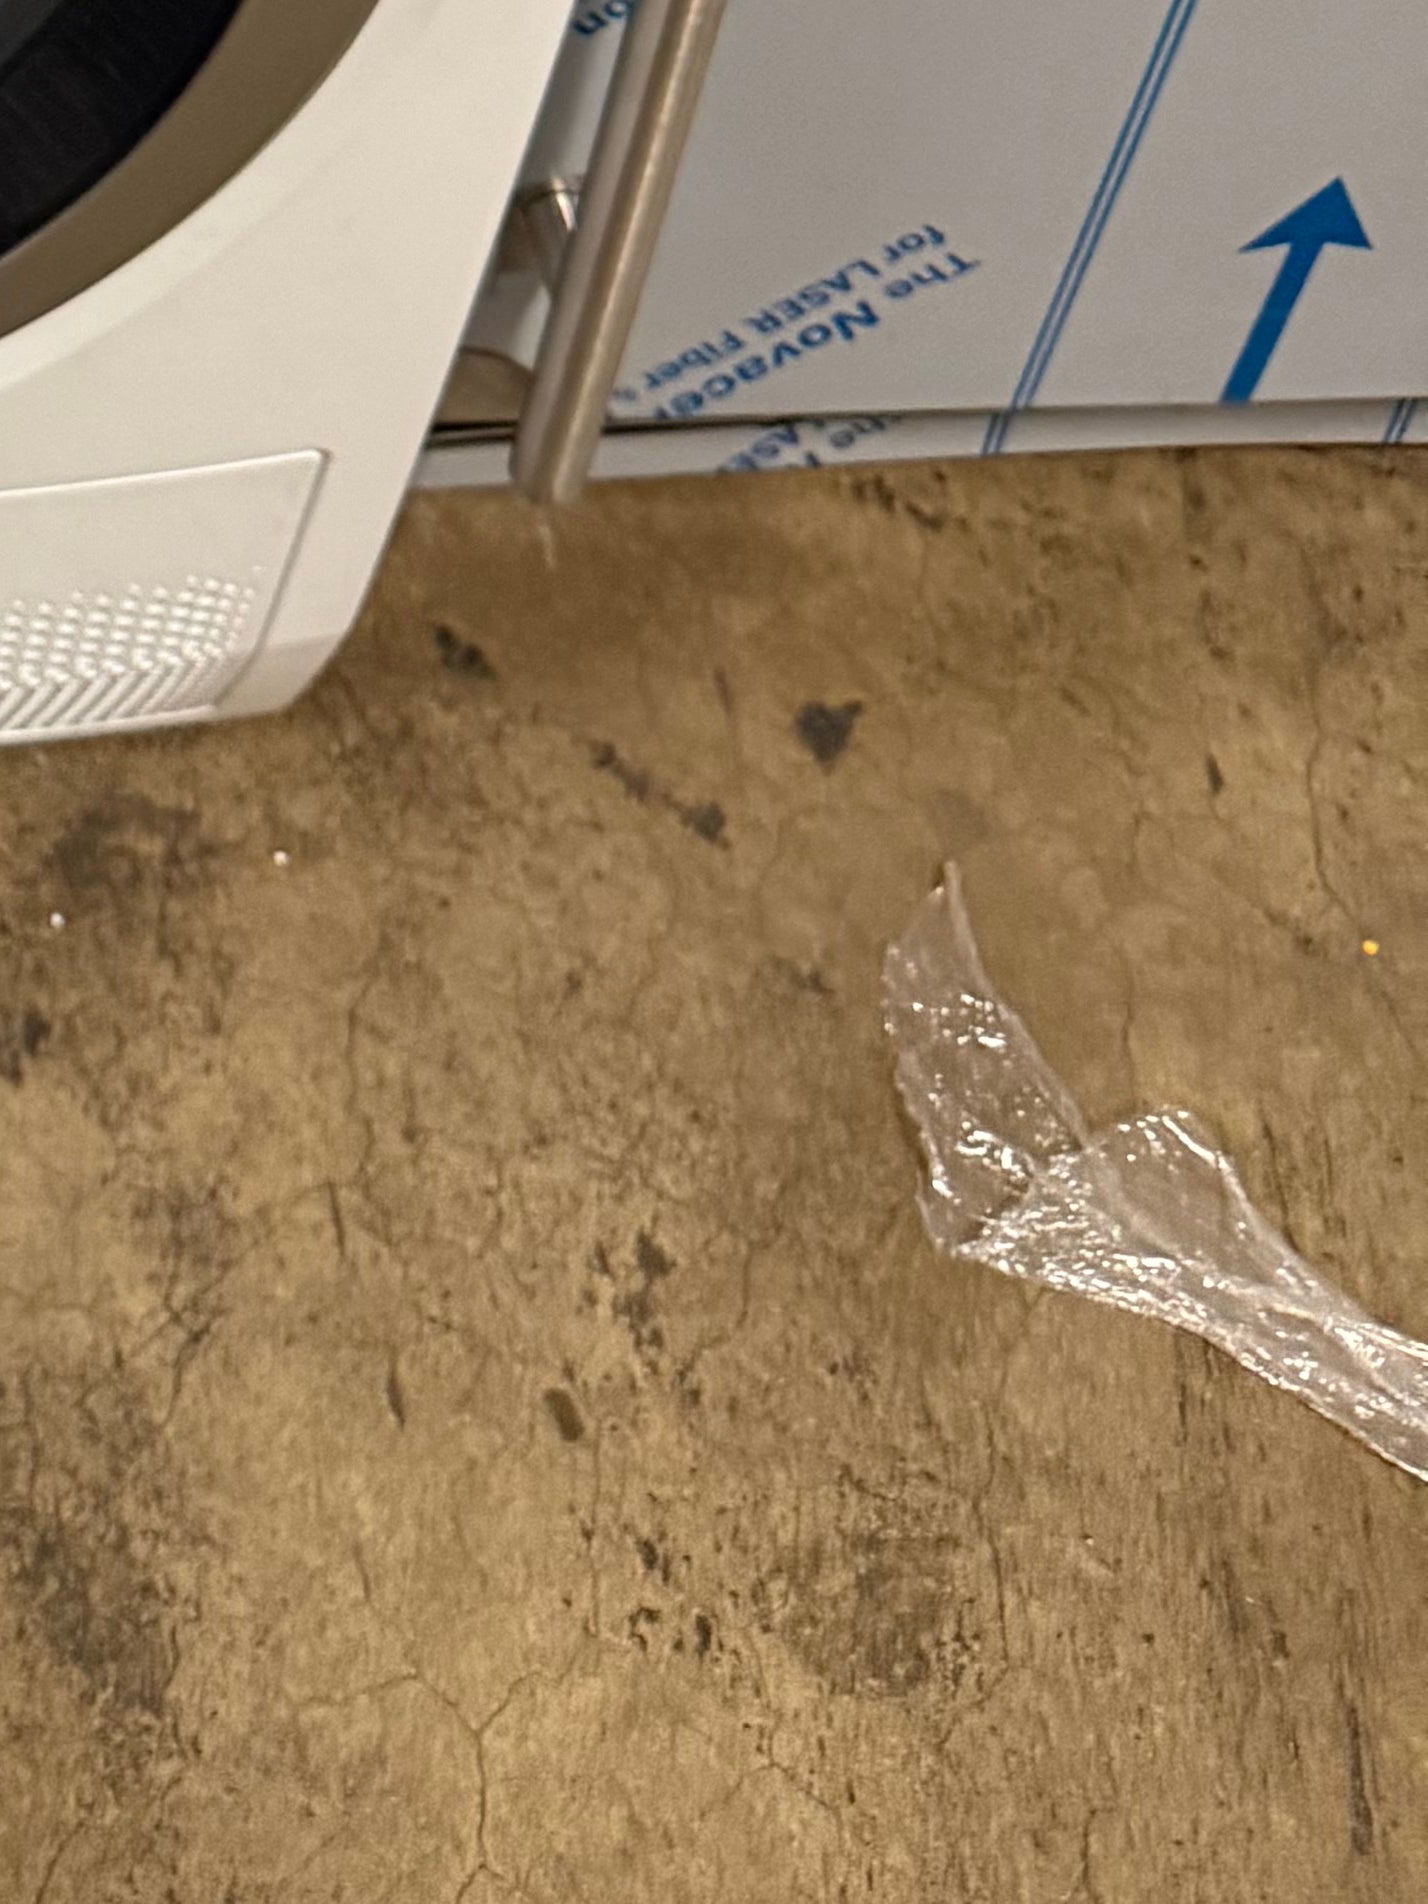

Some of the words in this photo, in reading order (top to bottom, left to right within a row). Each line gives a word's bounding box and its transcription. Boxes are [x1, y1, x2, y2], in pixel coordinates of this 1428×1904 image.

[883, 223, 946, 266] for
[745, 258, 882, 335] LASER
[884, 251, 982, 300] The
[644, 329, 747, 390] Fiber
